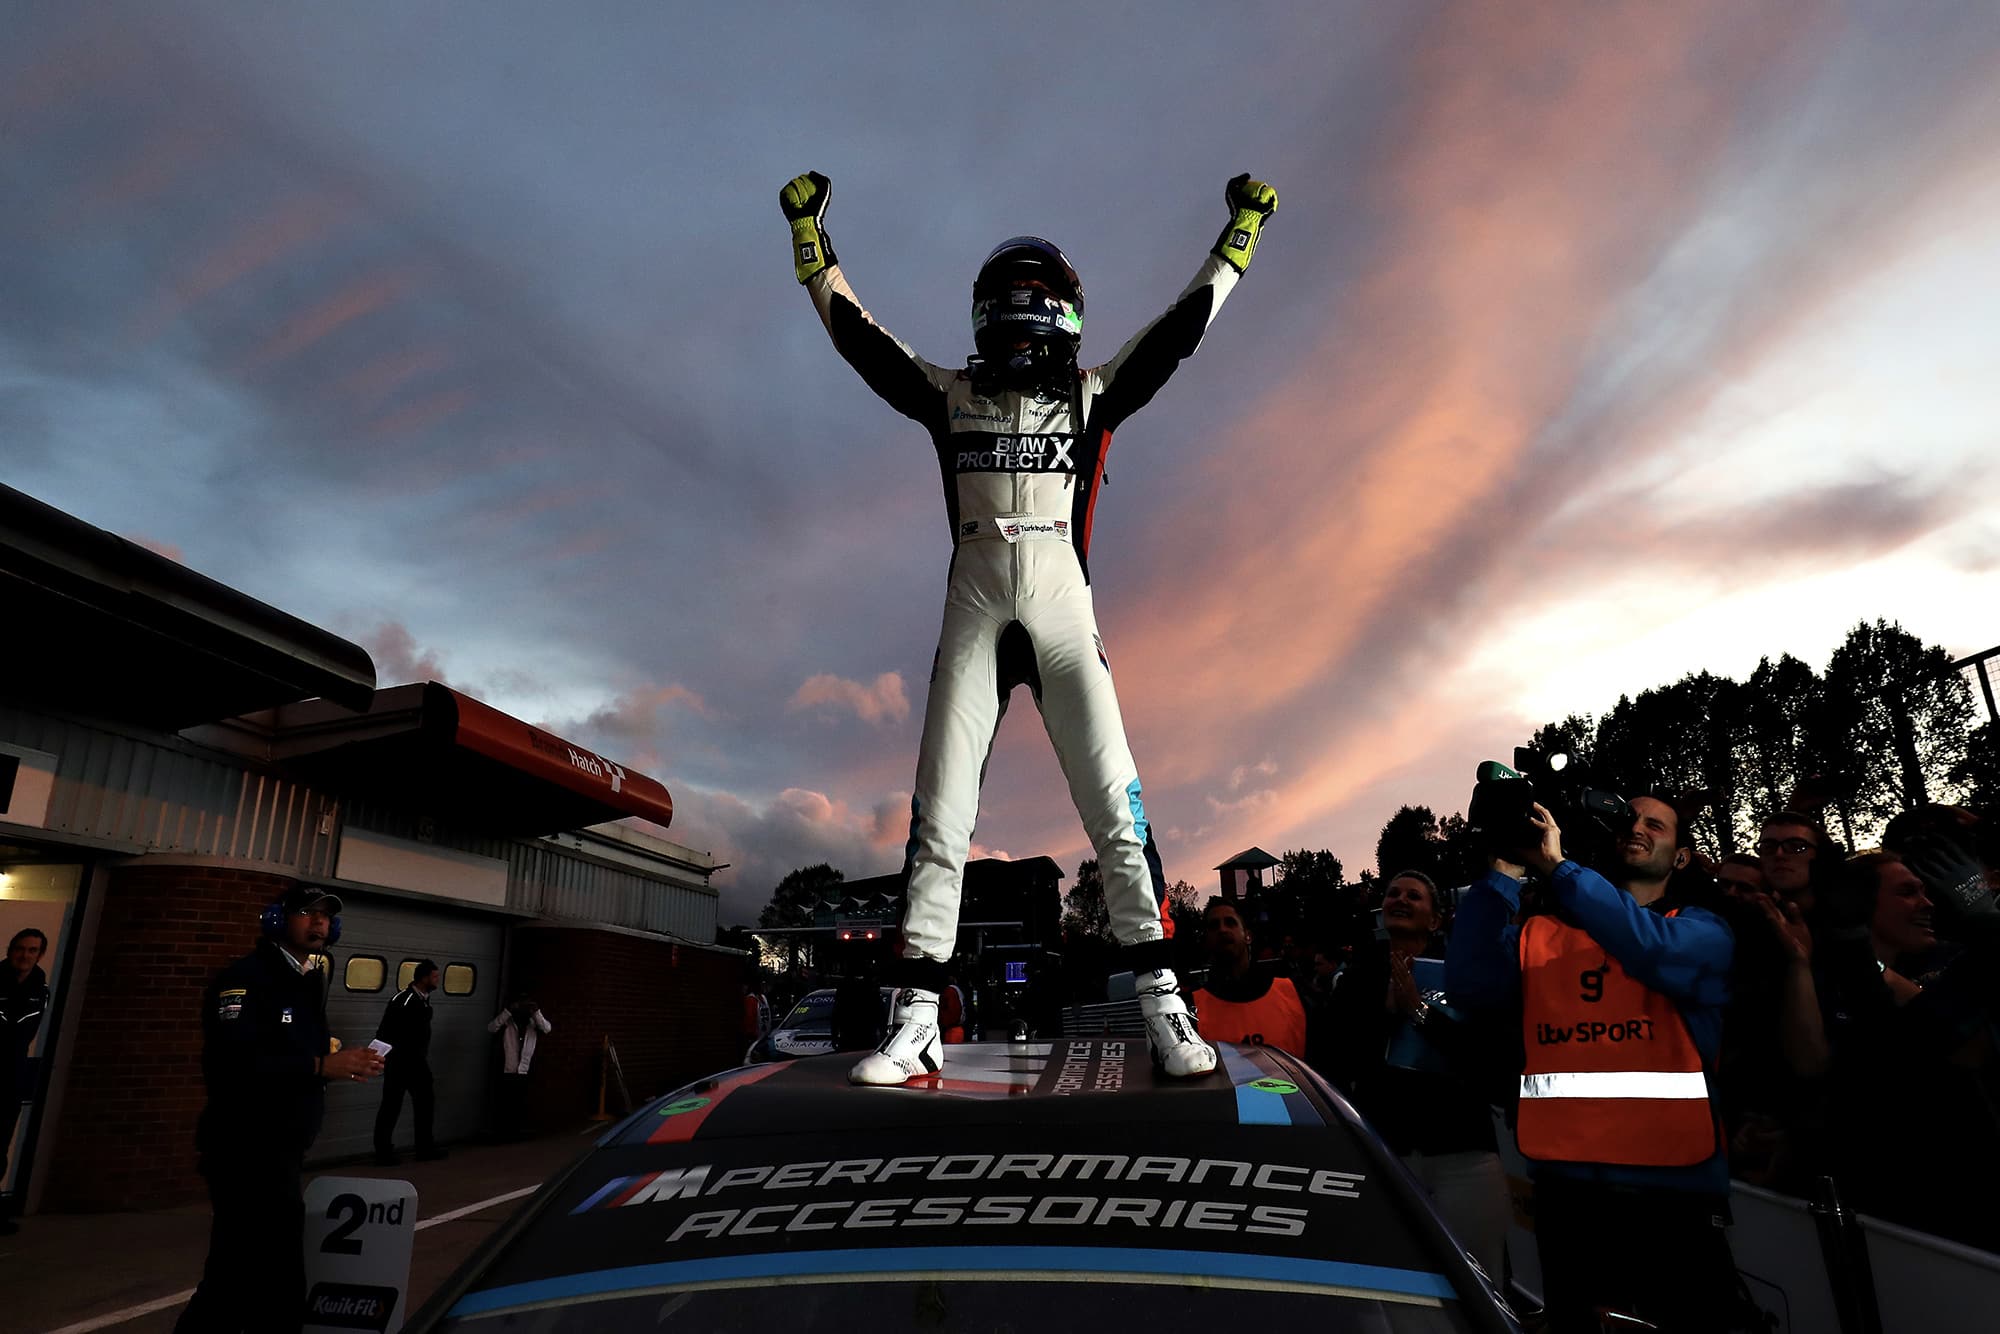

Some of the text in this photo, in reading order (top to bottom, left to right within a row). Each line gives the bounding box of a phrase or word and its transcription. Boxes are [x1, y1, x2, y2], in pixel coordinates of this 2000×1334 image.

[956, 437, 1077, 470] PROTECT X
[995, 436, 1048, 454] BMW
[1020, 524, 1054, 534] Turkington
[567, 747, 603, 778] Hatch
[1537, 1019, 1655, 1045] itv SPORT
[704, 1153, 1367, 1202] PERFORMANCE
[319, 1192, 405, 1256] 2nd
[665, 1196, 1309, 1244] ACCESSORIES
